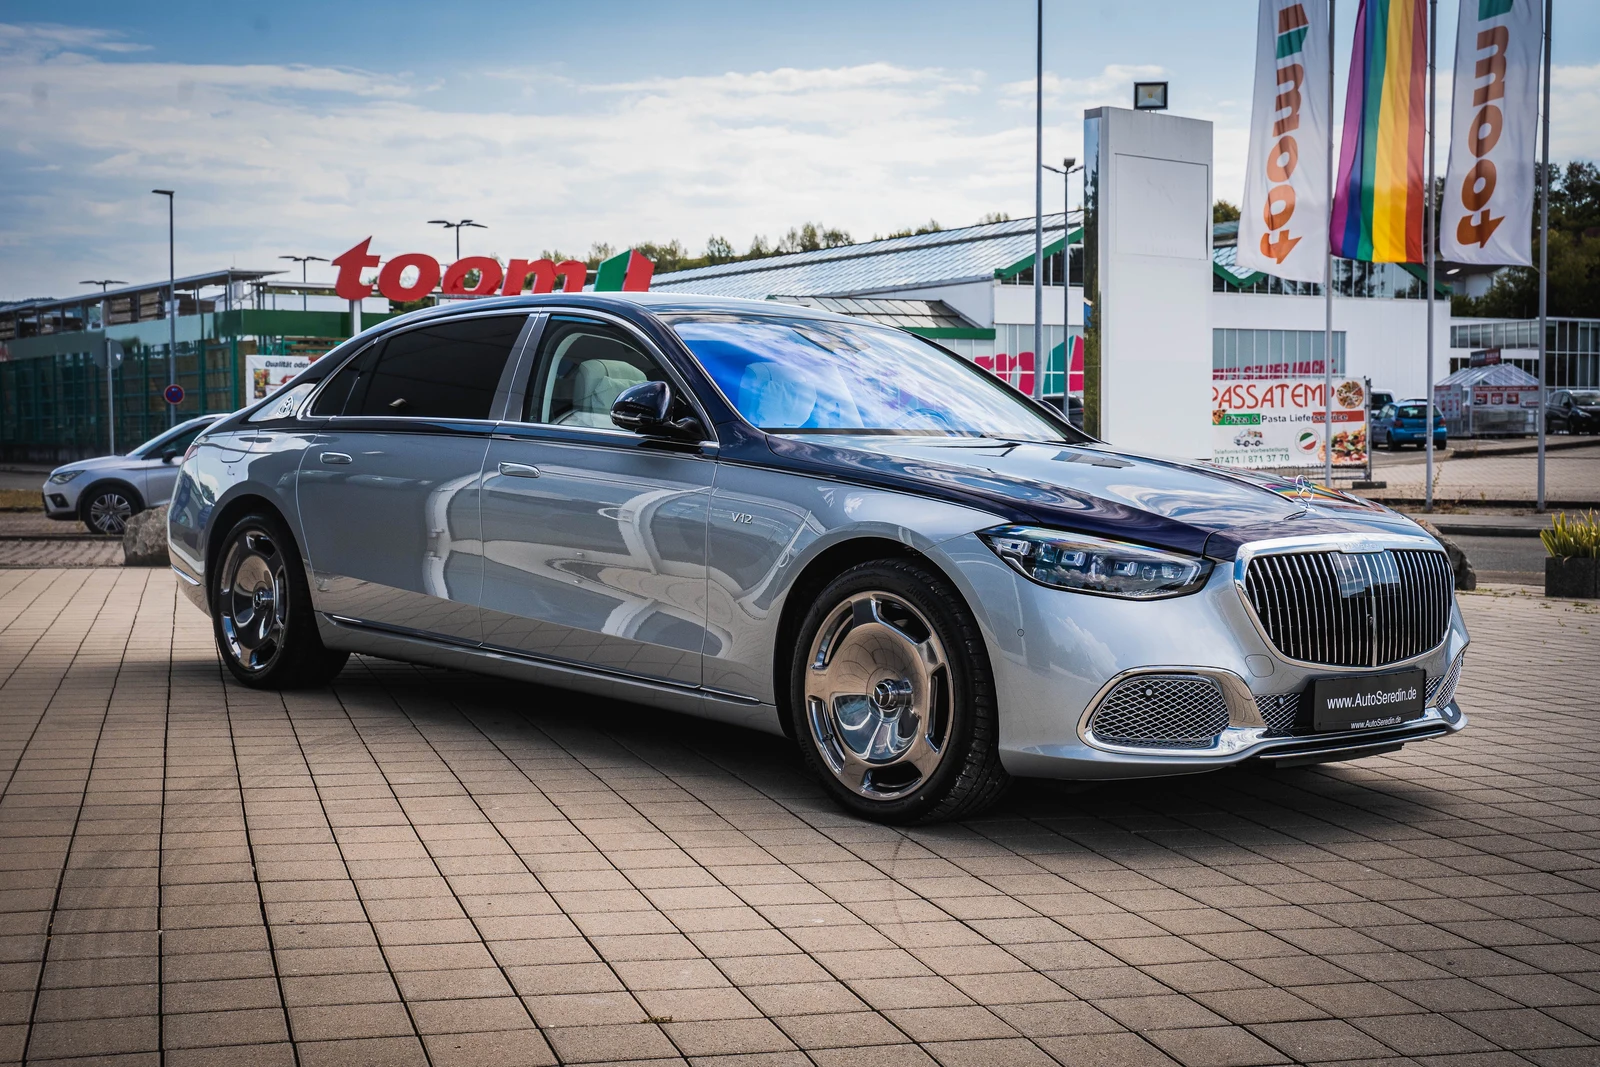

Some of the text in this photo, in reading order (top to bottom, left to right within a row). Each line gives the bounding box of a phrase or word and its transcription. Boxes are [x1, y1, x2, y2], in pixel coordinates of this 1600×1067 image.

[1456, 25, 1509, 249] toom
[1260, 63, 1304, 265] toom
[332, 236, 587, 302] toom
[1292, 358, 1337, 378] MACH.
[1225, 413, 1348, 424] Pizza & Pasta Lieferseice
[1249, 455, 1265, 463] 871
[1267, 454, 1279, 462] 37
[1280, 453, 1290, 461] 70
[731, 512, 753, 524] V12
[1327, 687, 1417, 709] www.AutoSeredin.de
[1350, 715, 1402, 729] www.AutoSeredin.de
